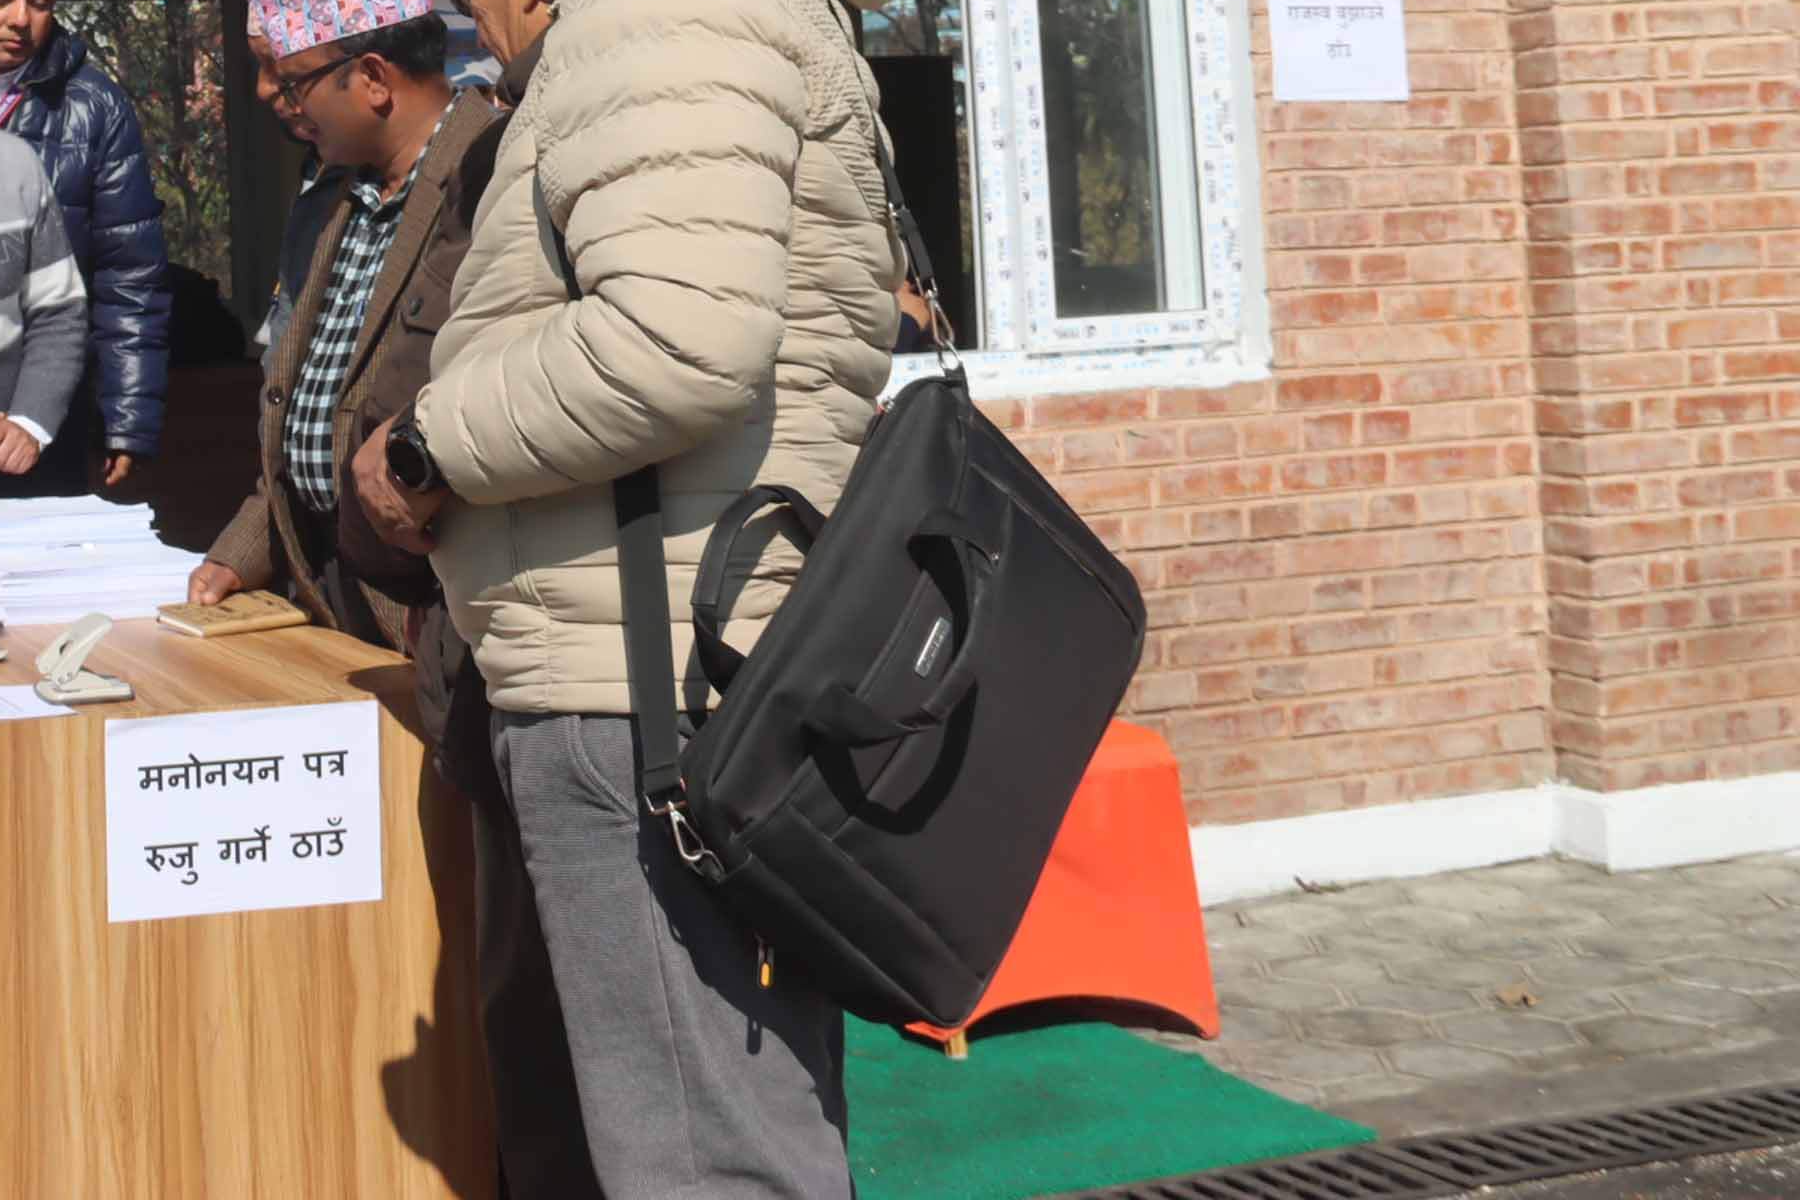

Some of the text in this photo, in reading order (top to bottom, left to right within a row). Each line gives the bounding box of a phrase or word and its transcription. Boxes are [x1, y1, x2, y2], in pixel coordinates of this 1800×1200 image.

[138, 750, 348, 792] मनोनयन पत्र
[144, 816, 347, 885] रुजु गर्ने ठाउँ
